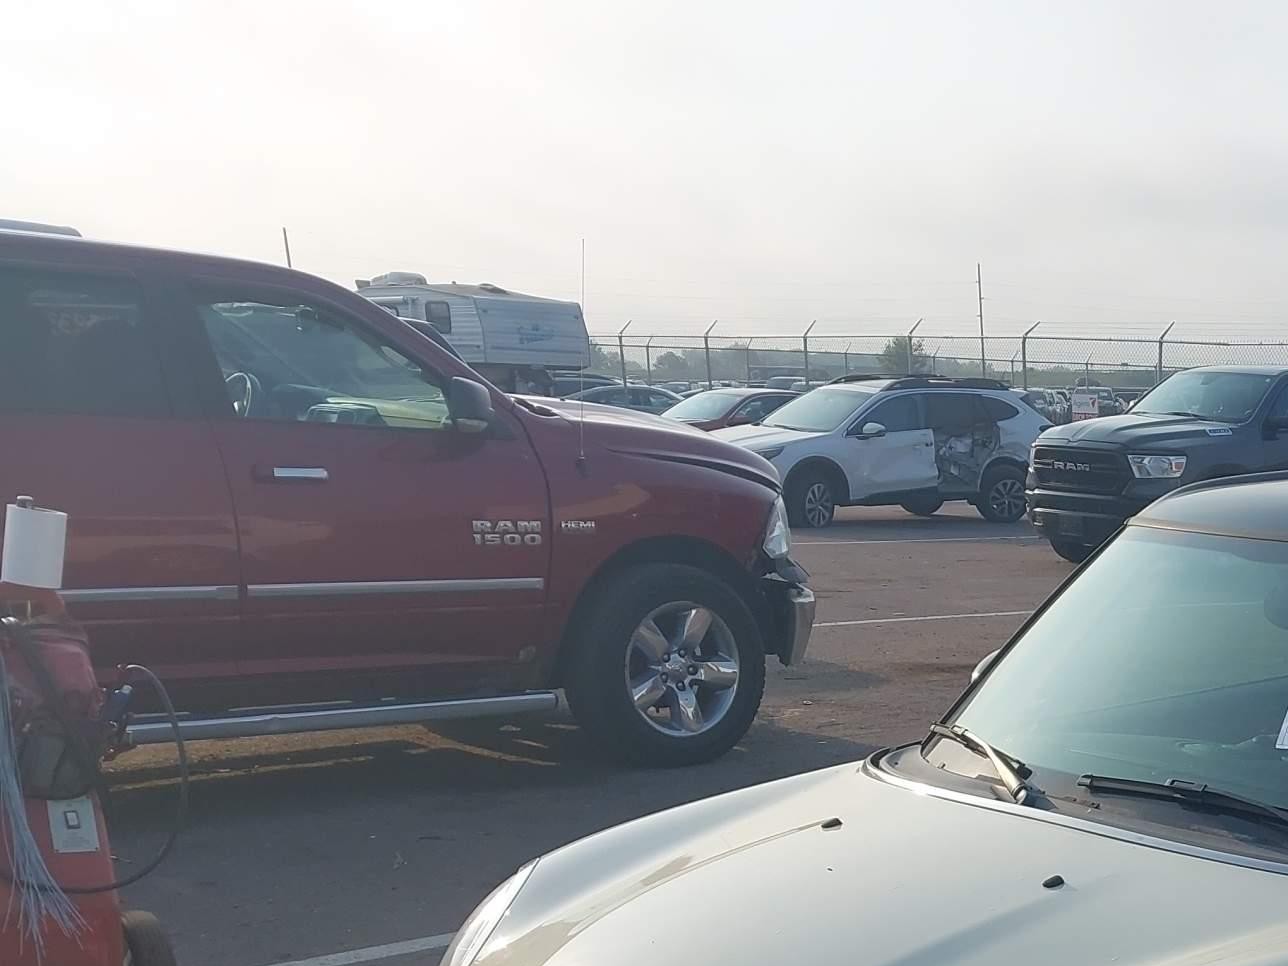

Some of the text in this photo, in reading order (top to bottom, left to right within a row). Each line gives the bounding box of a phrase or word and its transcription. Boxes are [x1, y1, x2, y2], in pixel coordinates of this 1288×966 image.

[1053, 461, 1090, 471] RAM
[472, 520, 541, 533] RAM
[561, 520, 595, 529] HEMI
[472, 534, 542, 545] 1500
